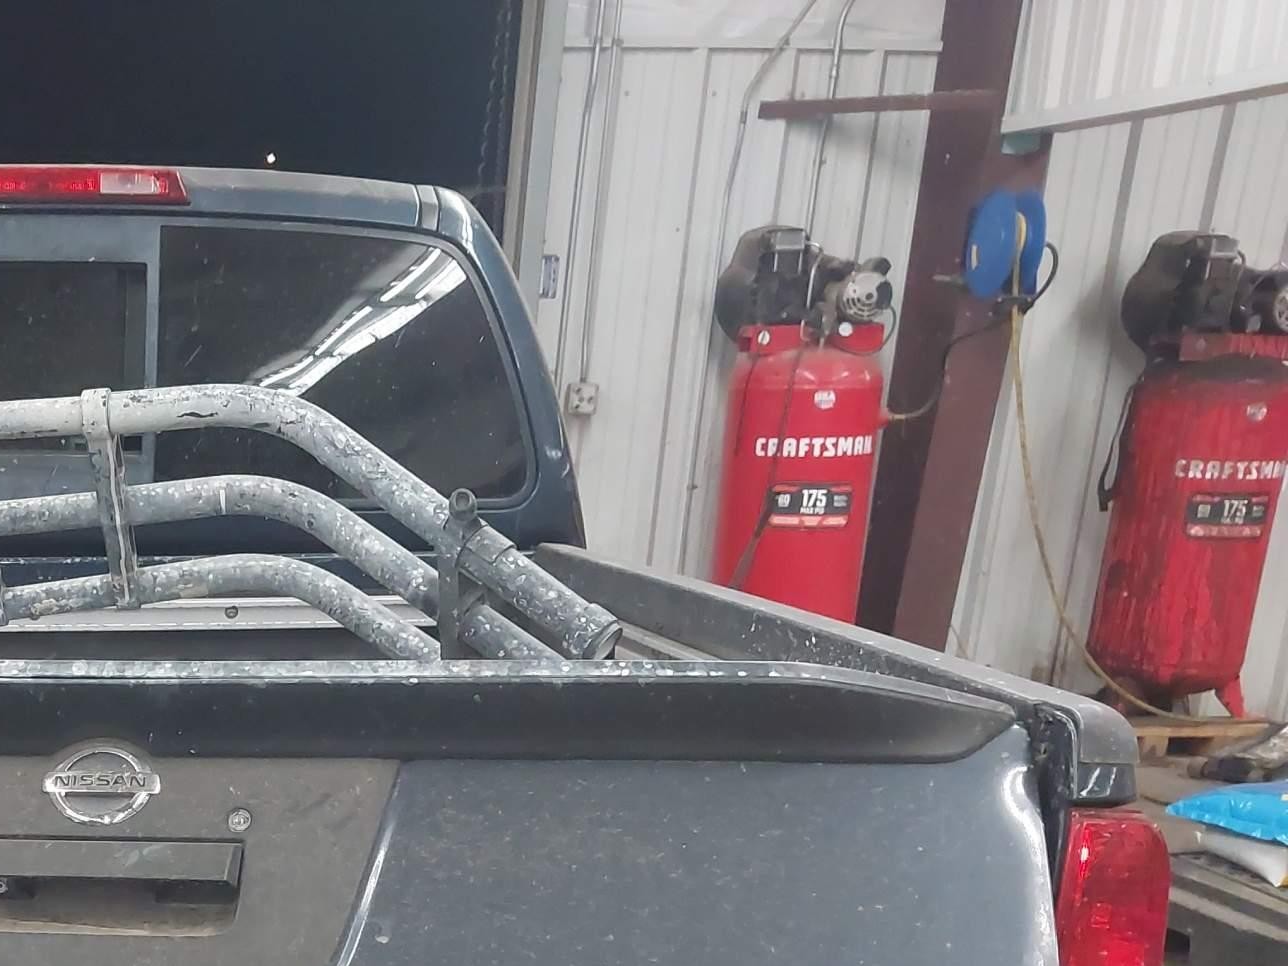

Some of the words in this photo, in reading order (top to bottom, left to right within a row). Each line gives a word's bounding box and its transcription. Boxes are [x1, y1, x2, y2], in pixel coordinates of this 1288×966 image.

[755, 435, 872, 457] CRAFTSMAN
[1175, 459, 1287, 479] CRAFTSMA
[802, 489, 827, 507] 175
[1223, 499, 1248, 517] 175
[54, 775, 146, 787] NISSAN
